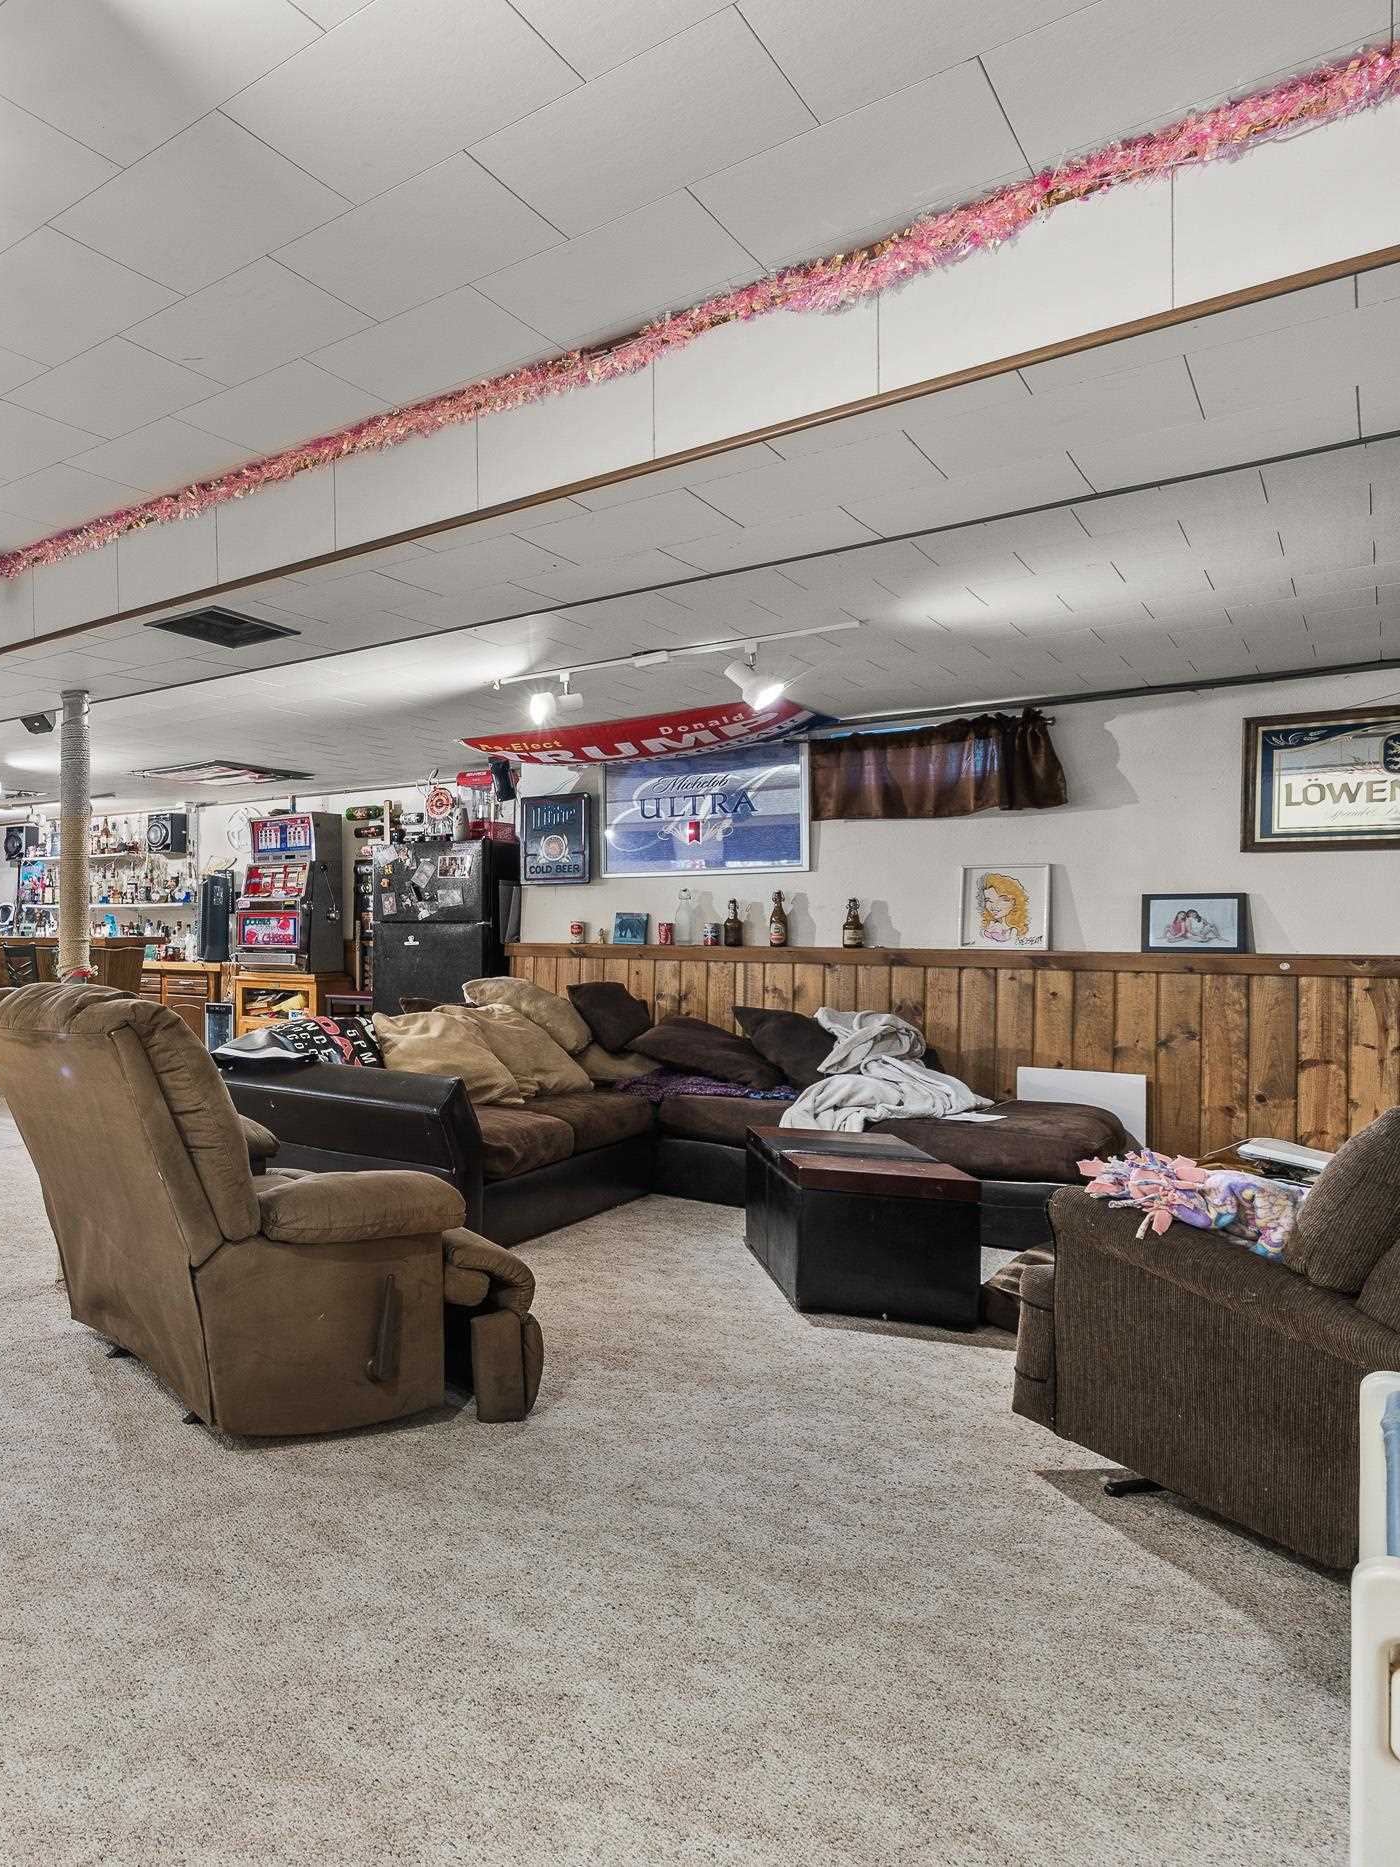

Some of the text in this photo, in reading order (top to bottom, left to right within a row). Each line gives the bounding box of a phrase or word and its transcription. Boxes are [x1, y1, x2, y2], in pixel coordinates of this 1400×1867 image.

[659, 712, 744, 735] Donald
[652, 774, 730, 793] Michelob
[640, 790, 758, 819] ULTRA
[529, 864, 581, 874] COLD BEER
